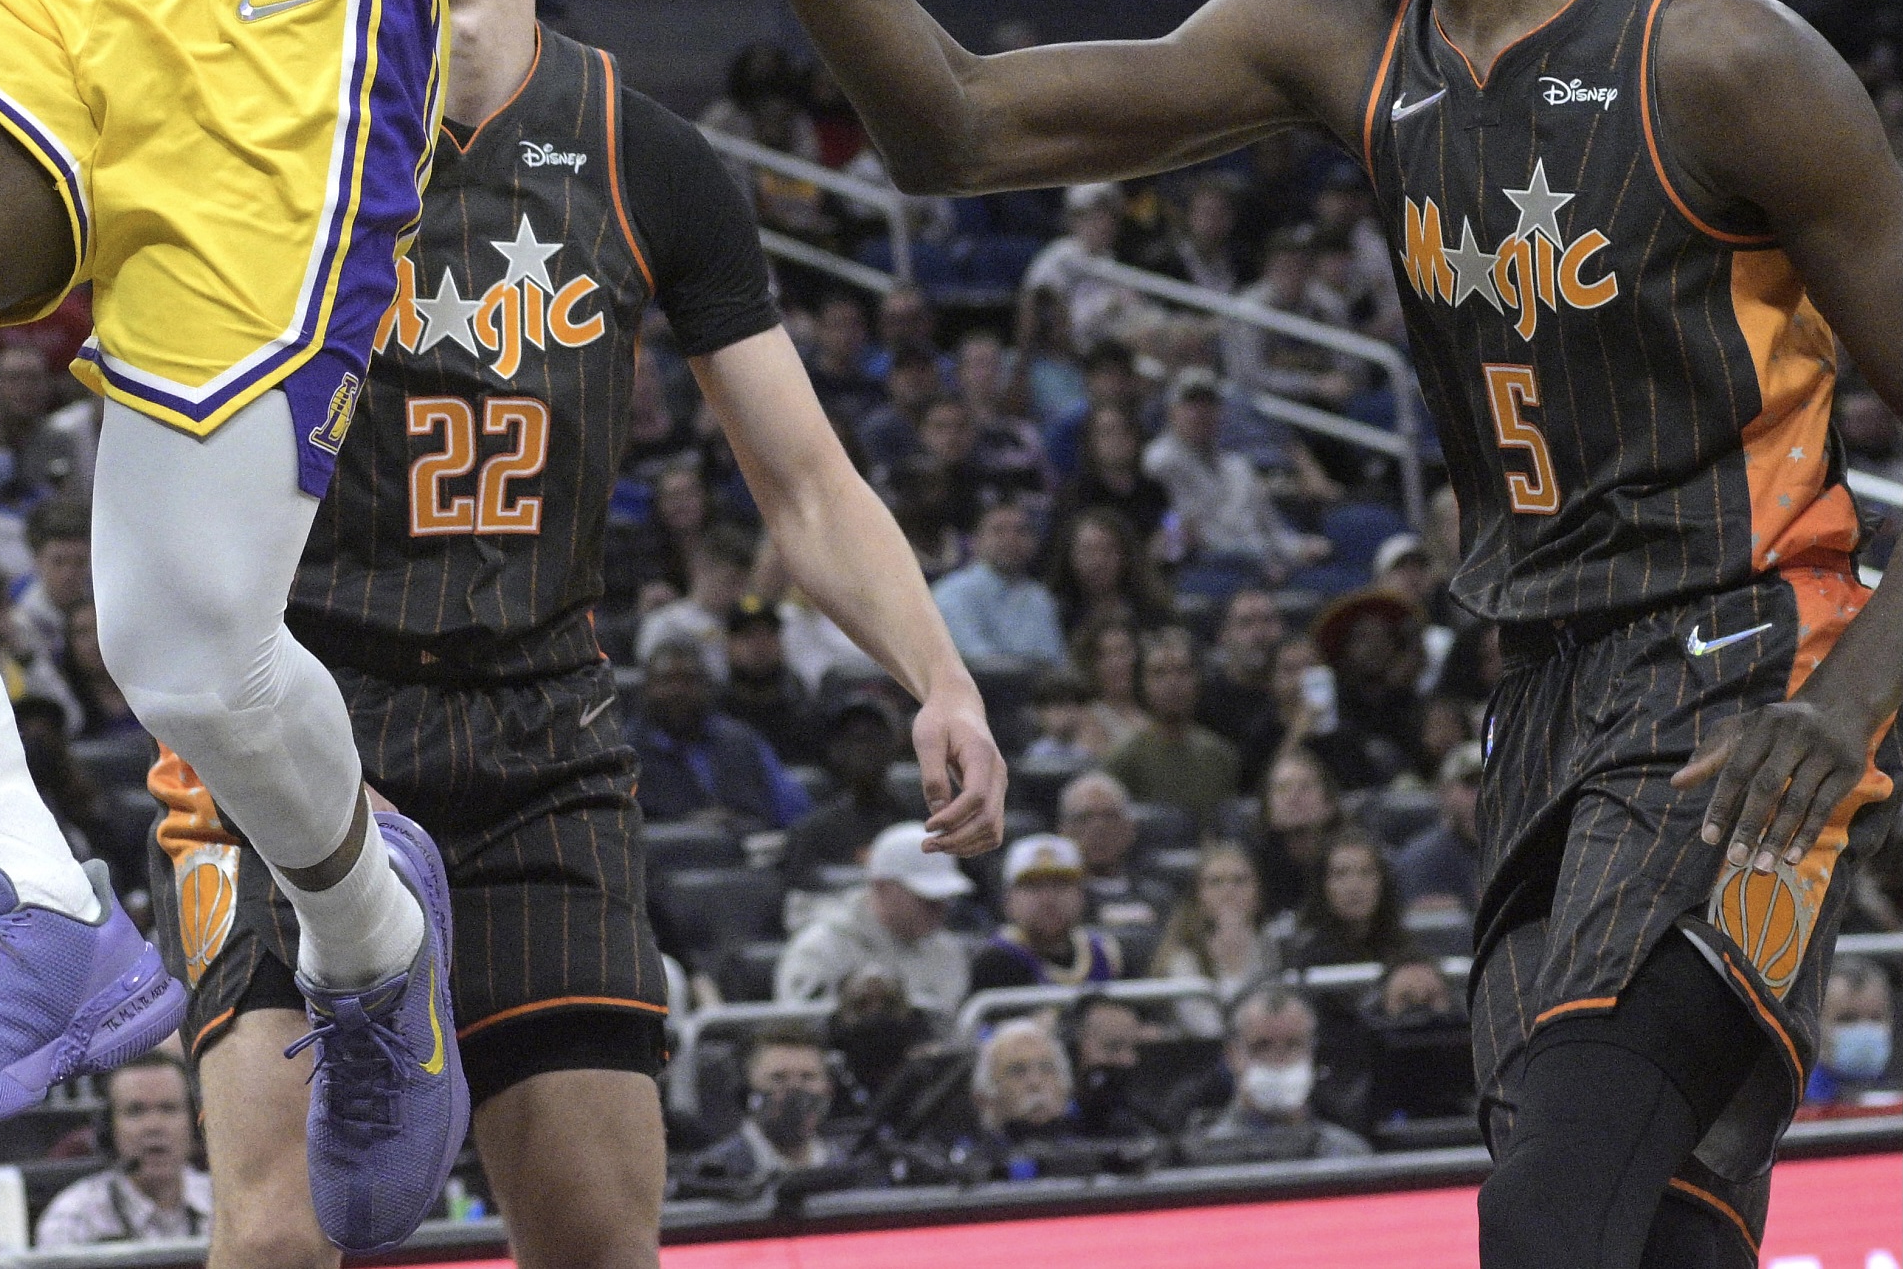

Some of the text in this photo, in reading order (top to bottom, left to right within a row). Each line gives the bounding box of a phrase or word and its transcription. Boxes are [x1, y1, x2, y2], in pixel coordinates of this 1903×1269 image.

[1539, 77, 1618, 109] Disney
[520, 141, 588, 172] Disney
[407, 395, 551, 537] 22
[1482, 363, 1562, 516] 5
